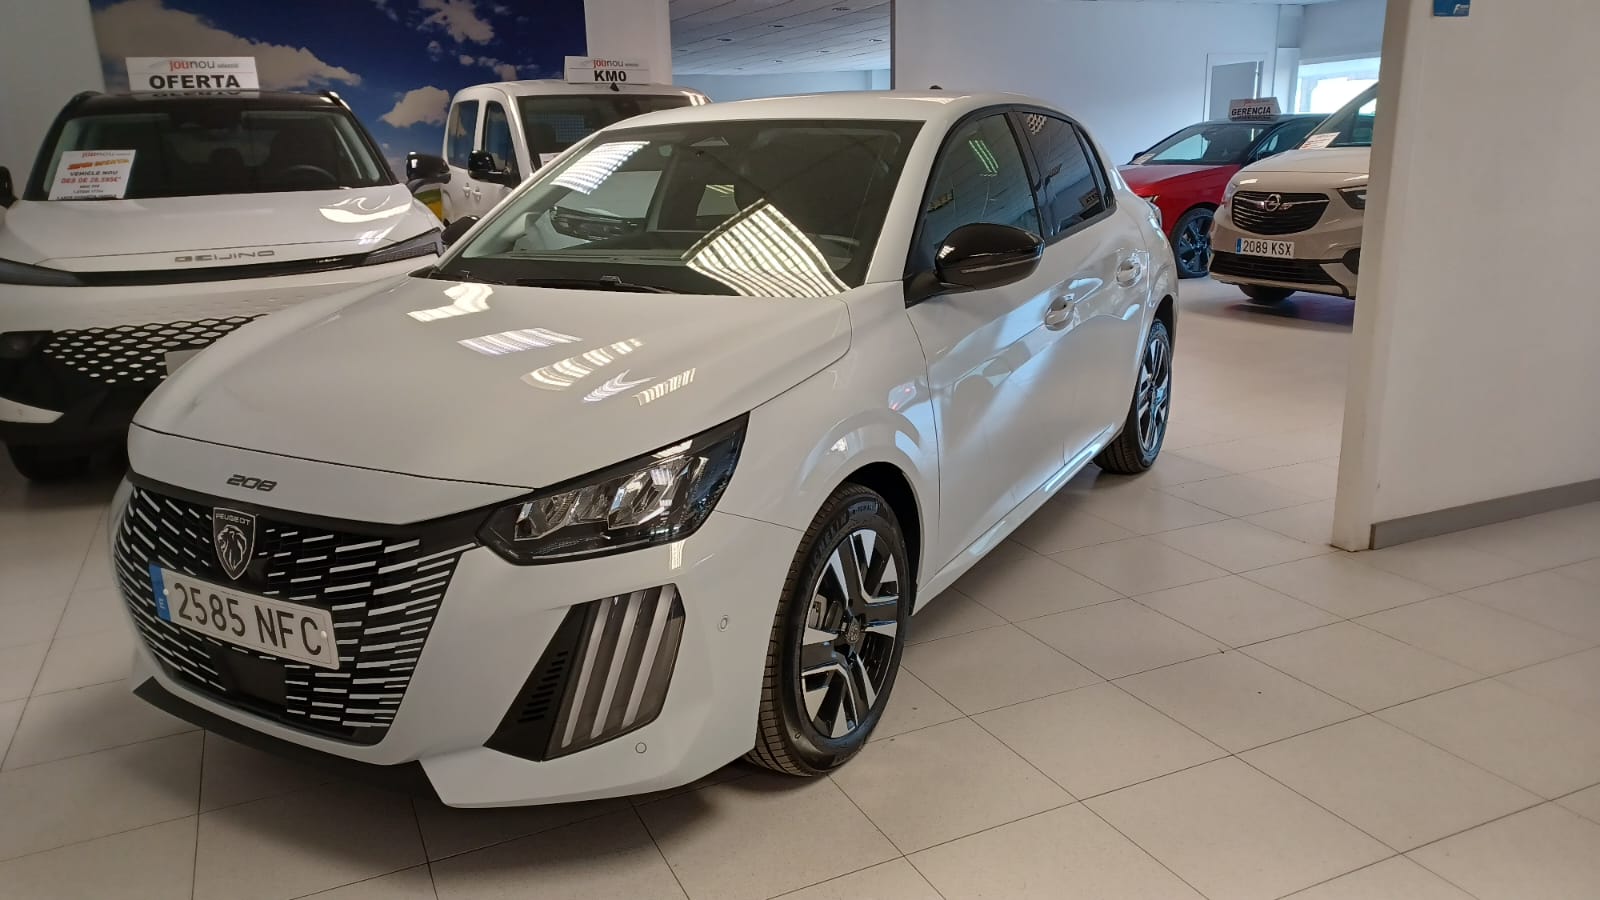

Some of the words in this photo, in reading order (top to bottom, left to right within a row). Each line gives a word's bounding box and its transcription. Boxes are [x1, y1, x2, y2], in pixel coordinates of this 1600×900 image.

[169, 59, 215, 71] jounou
[593, 59, 623, 69] jounou
[148, 75, 241, 89] OFERTA
[1231, 106, 1271, 116] GERENCIA
[1243, 240, 1268, 254] 2089
[1271, 242, 1292, 256] KSX
[226, 474, 278, 492] 208
[215, 513, 250, 525] PEUGEOT
[174, 582, 246, 637] 2585
[254, 605, 322, 656] NFC
